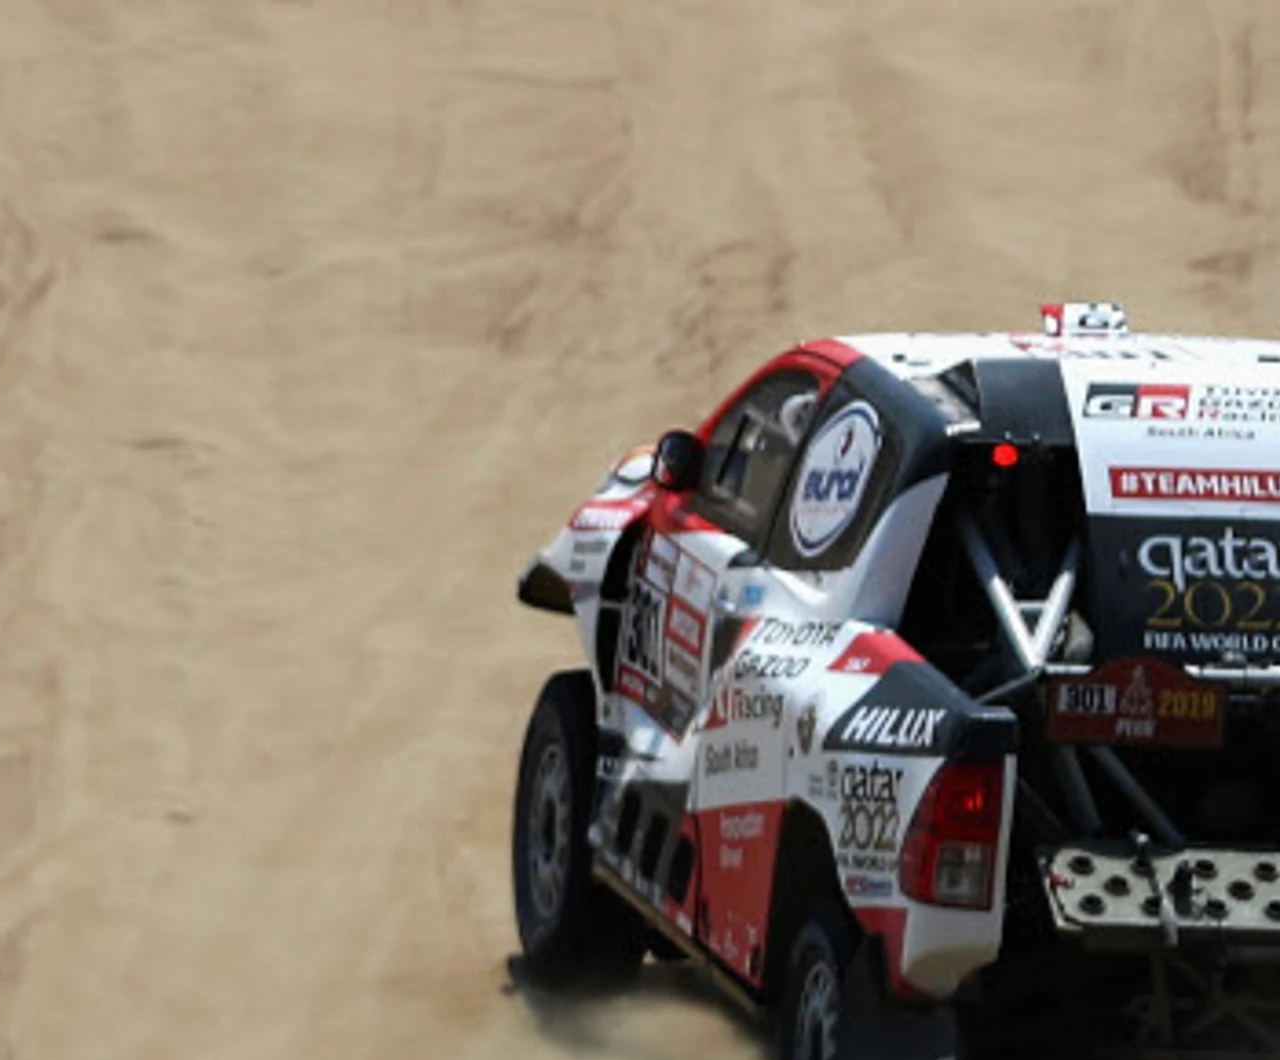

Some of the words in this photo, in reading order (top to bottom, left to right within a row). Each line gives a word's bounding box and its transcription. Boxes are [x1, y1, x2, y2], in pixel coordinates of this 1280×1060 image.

[752, 617, 842, 646] TOYOTA
[1144, 630, 1186, 650] FIFA
[1190, 631, 1267, 652] WORLD
[734, 650, 810, 679] GAZOO
[1066, 686, 1111, 711] 301
[1158, 691, 1216, 720] 2019
[841, 705, 947, 748] HILUX
[840, 758, 904, 801] qatar
